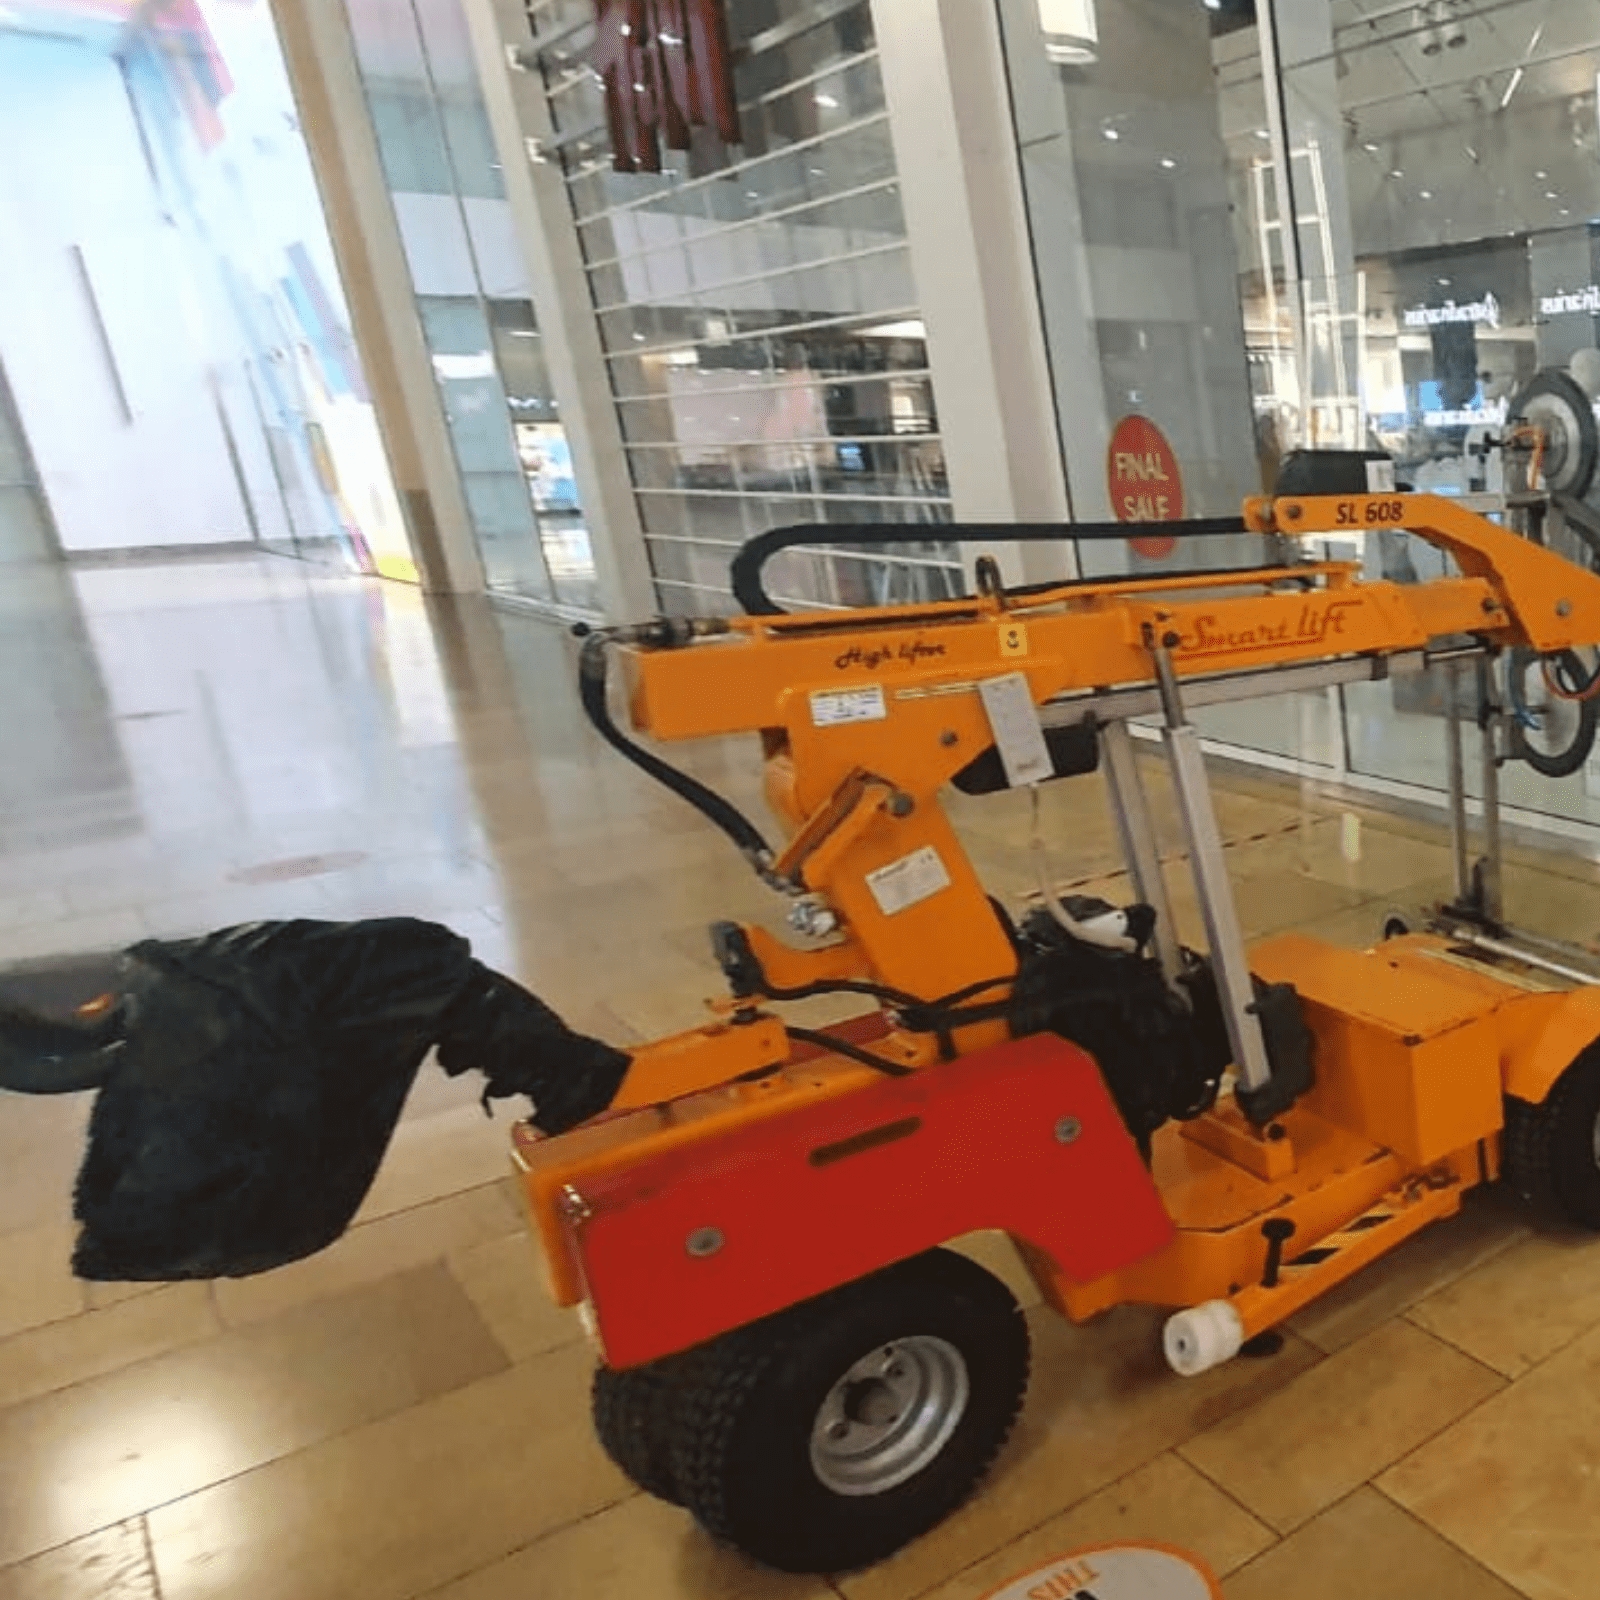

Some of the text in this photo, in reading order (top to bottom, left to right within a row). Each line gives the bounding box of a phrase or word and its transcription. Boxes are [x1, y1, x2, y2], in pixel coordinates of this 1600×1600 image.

[1115, 452, 1169, 481] FINAL
[1124, 495, 1171, 521] SALE
[1335, 501, 1404, 524] SL 608
[1180, 615, 1293, 652] Smart
